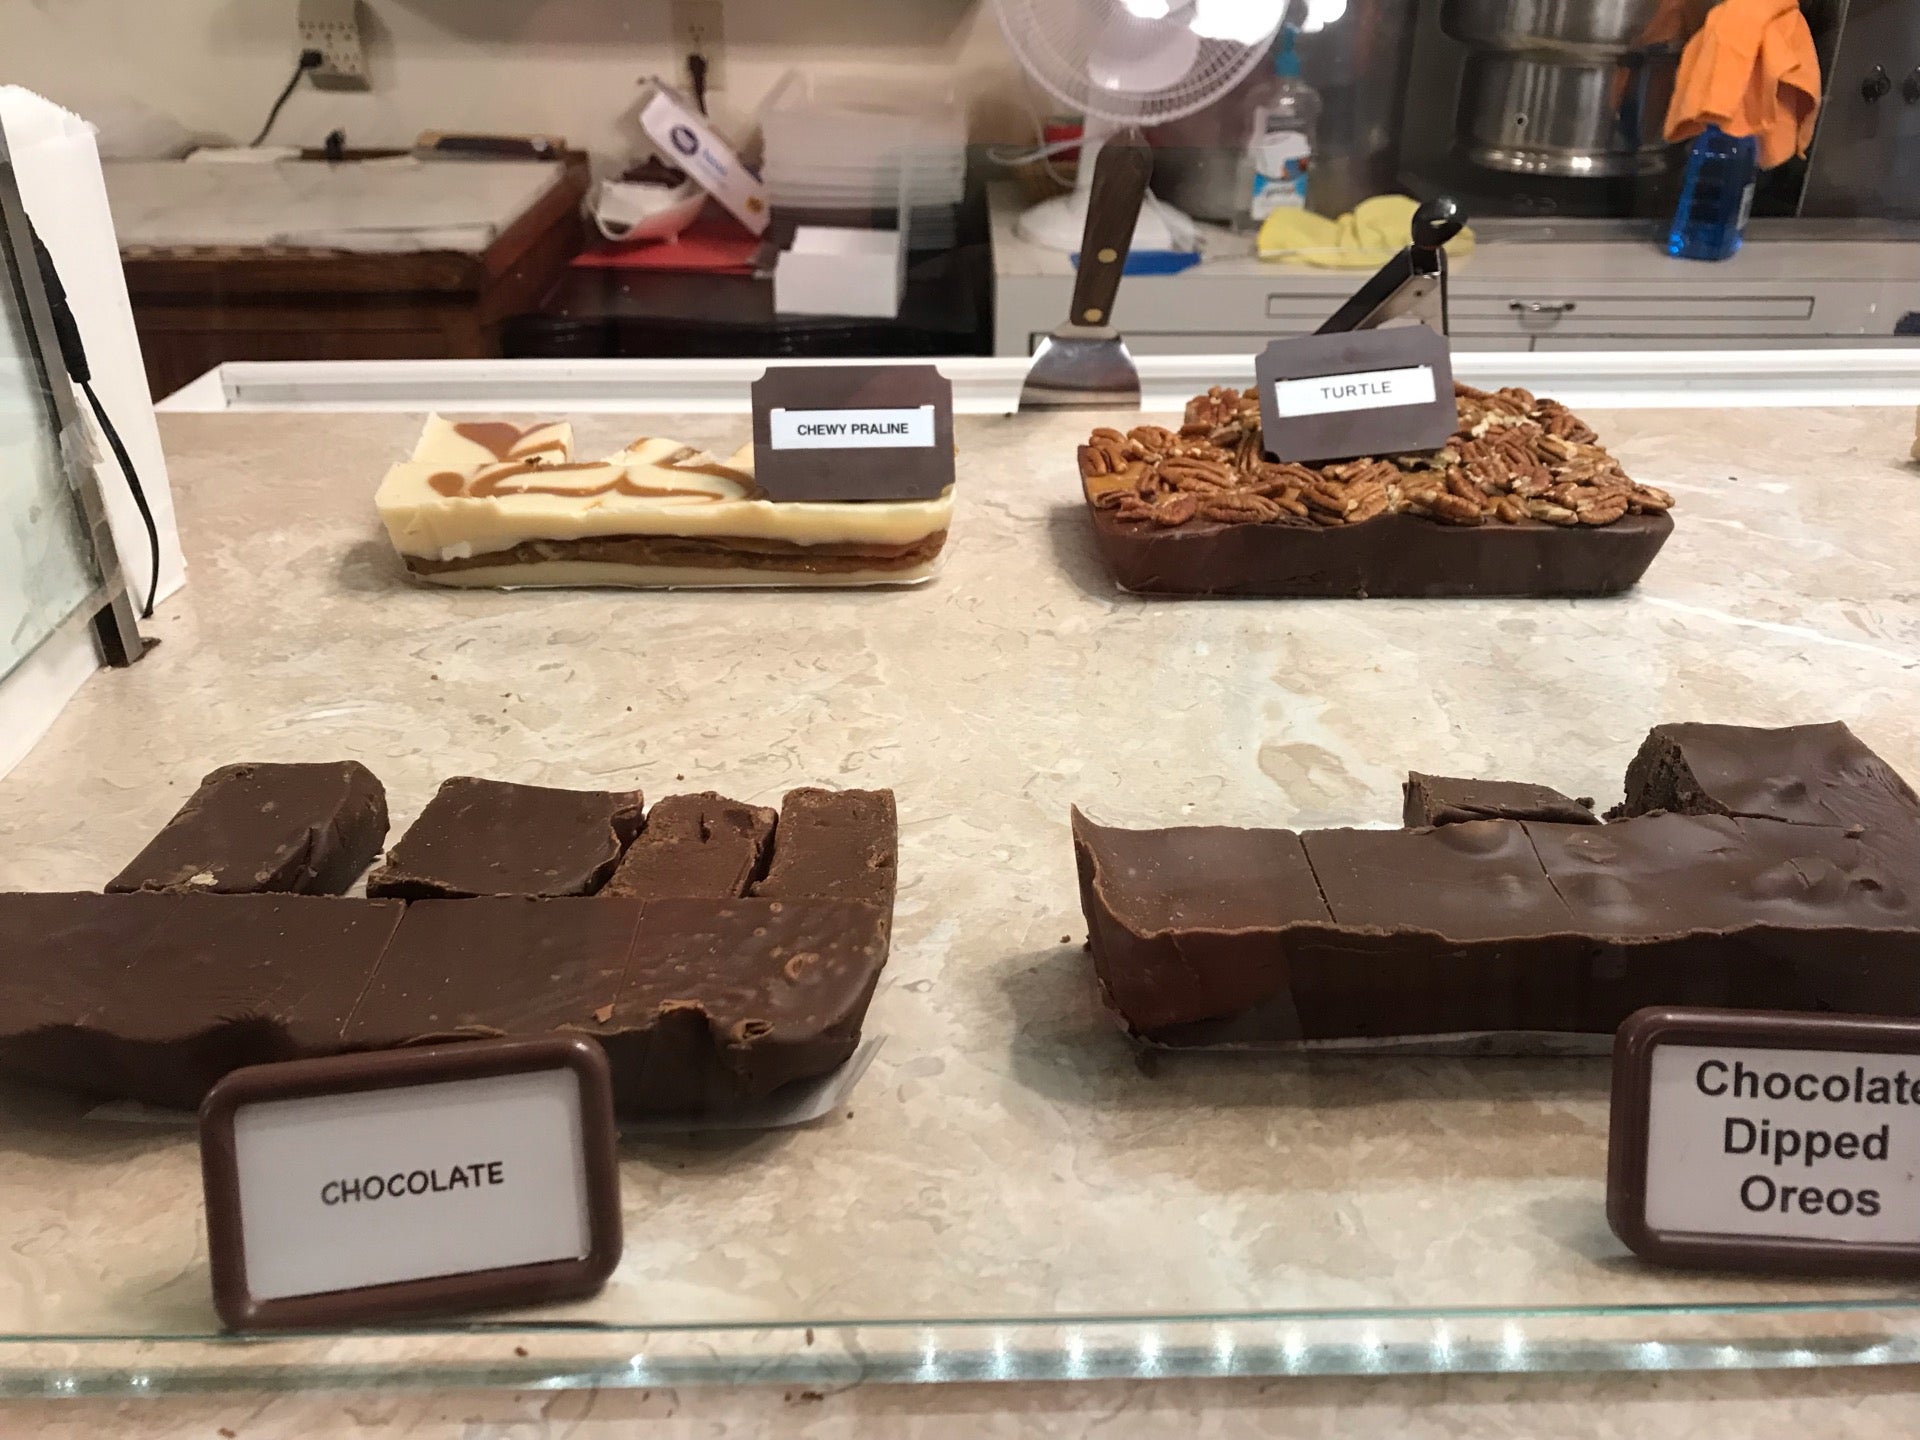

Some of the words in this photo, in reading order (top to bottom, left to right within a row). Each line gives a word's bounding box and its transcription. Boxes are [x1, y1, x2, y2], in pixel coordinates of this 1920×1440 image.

[1320, 380, 1393, 400] TURTLE
[797, 423, 847, 436] CHEWY
[851, 423, 909, 435] PRALINE
[1724, 1117, 1890, 1167] Dipped
[321, 1161, 505, 1206] CHOCOLATE
[1740, 1174, 1882, 1217] Oreos
